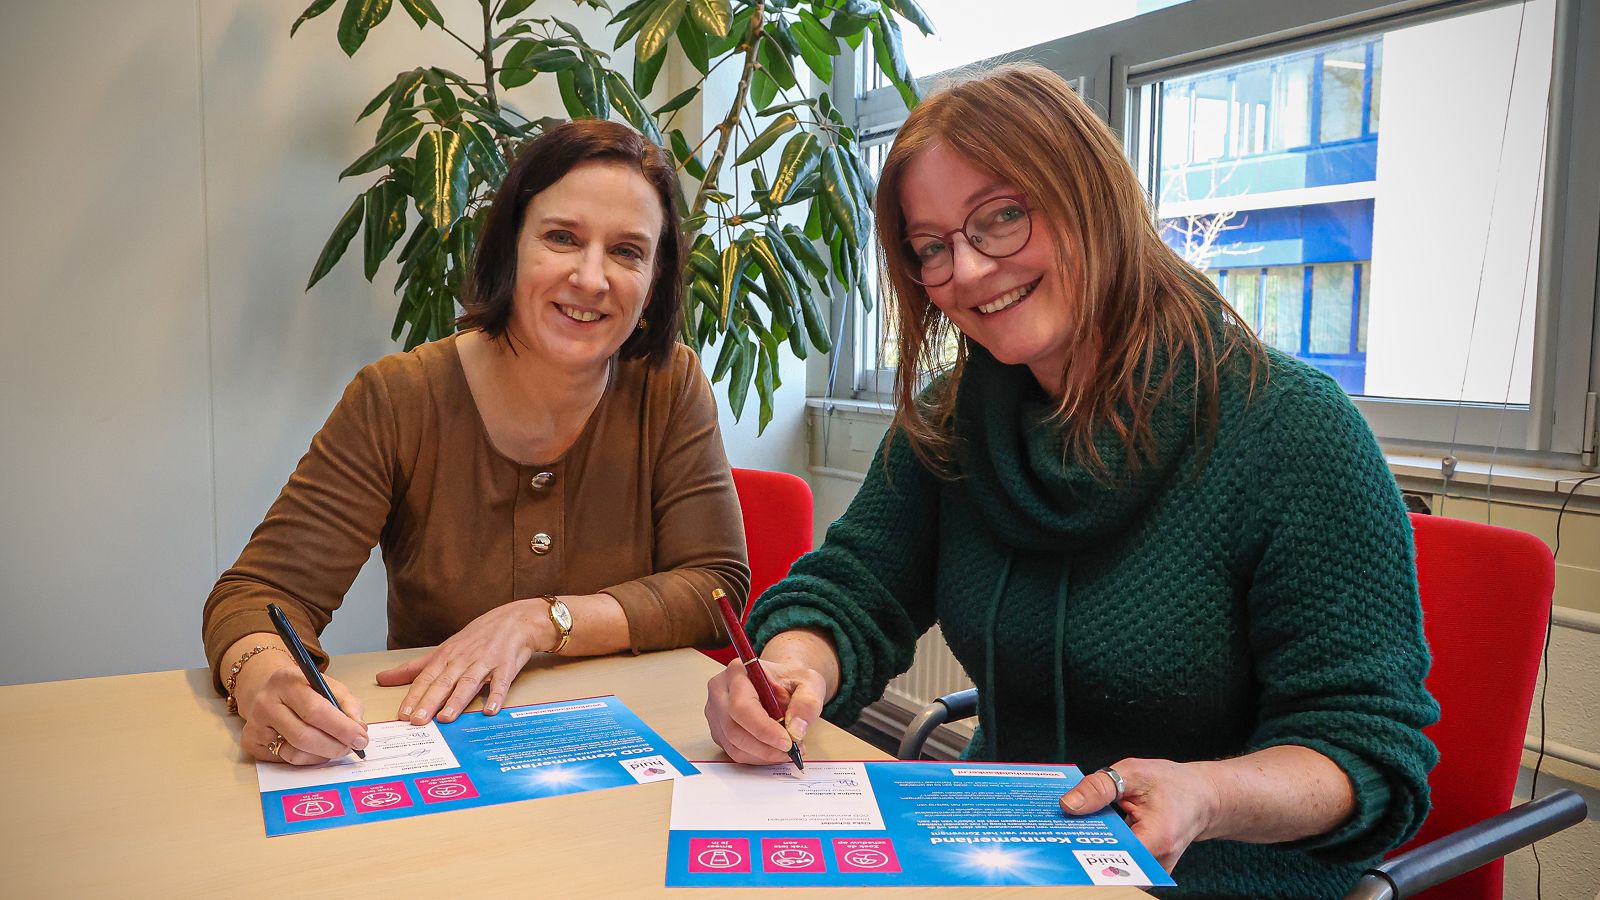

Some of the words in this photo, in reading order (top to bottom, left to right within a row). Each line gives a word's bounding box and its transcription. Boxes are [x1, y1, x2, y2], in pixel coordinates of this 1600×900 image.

[620, 747, 654, 755] GGD
[500, 752, 617, 773] Kennemerland
[630, 760, 664, 770] huid
[930, 837, 1072, 845] Kennemerland
[1086, 857, 1129, 866] huid
